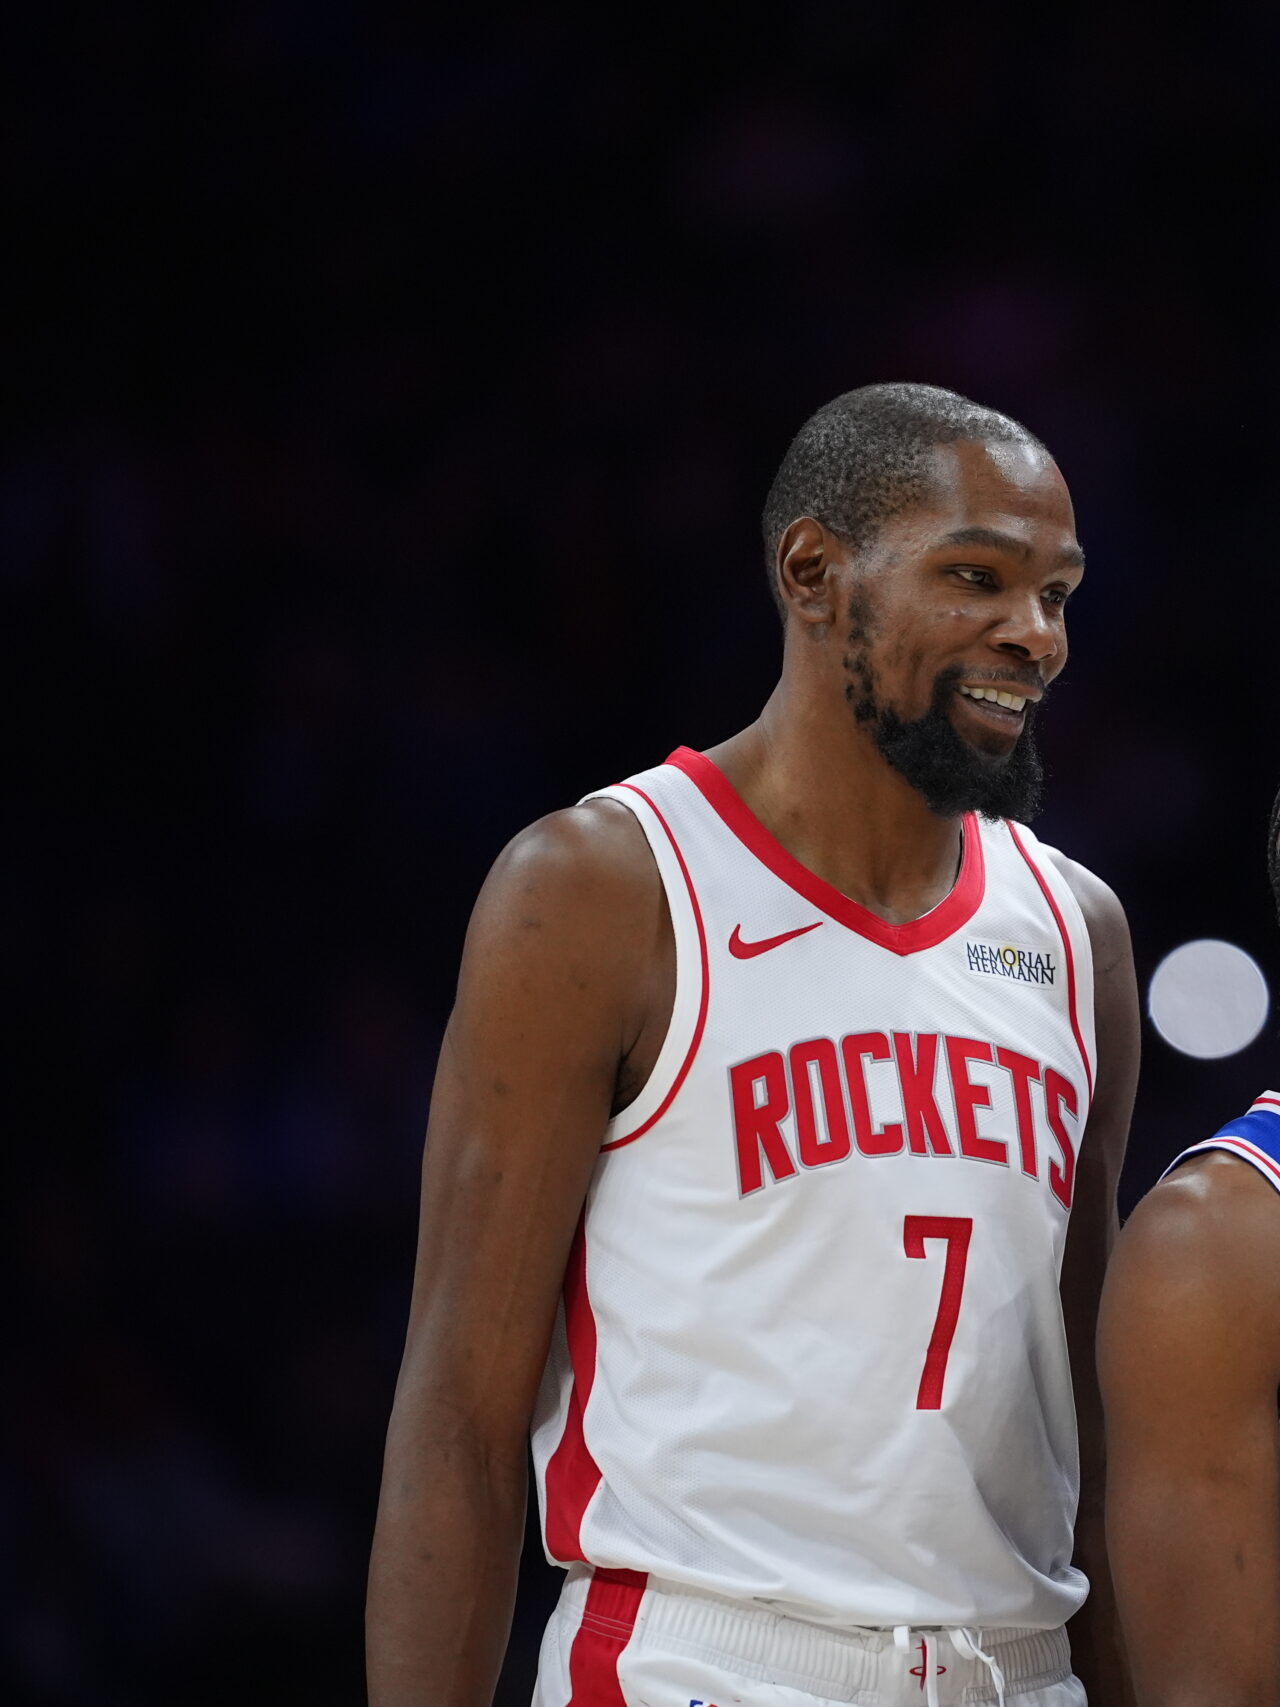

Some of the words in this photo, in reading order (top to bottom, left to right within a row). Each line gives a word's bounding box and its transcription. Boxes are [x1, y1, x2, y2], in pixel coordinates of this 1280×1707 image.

[966, 941, 1056, 971] MEMORIAL
[968, 956, 1055, 985] HERMANN
[727, 1029, 1080, 1212] ROCKETS
[903, 1215, 974, 1410] 7
